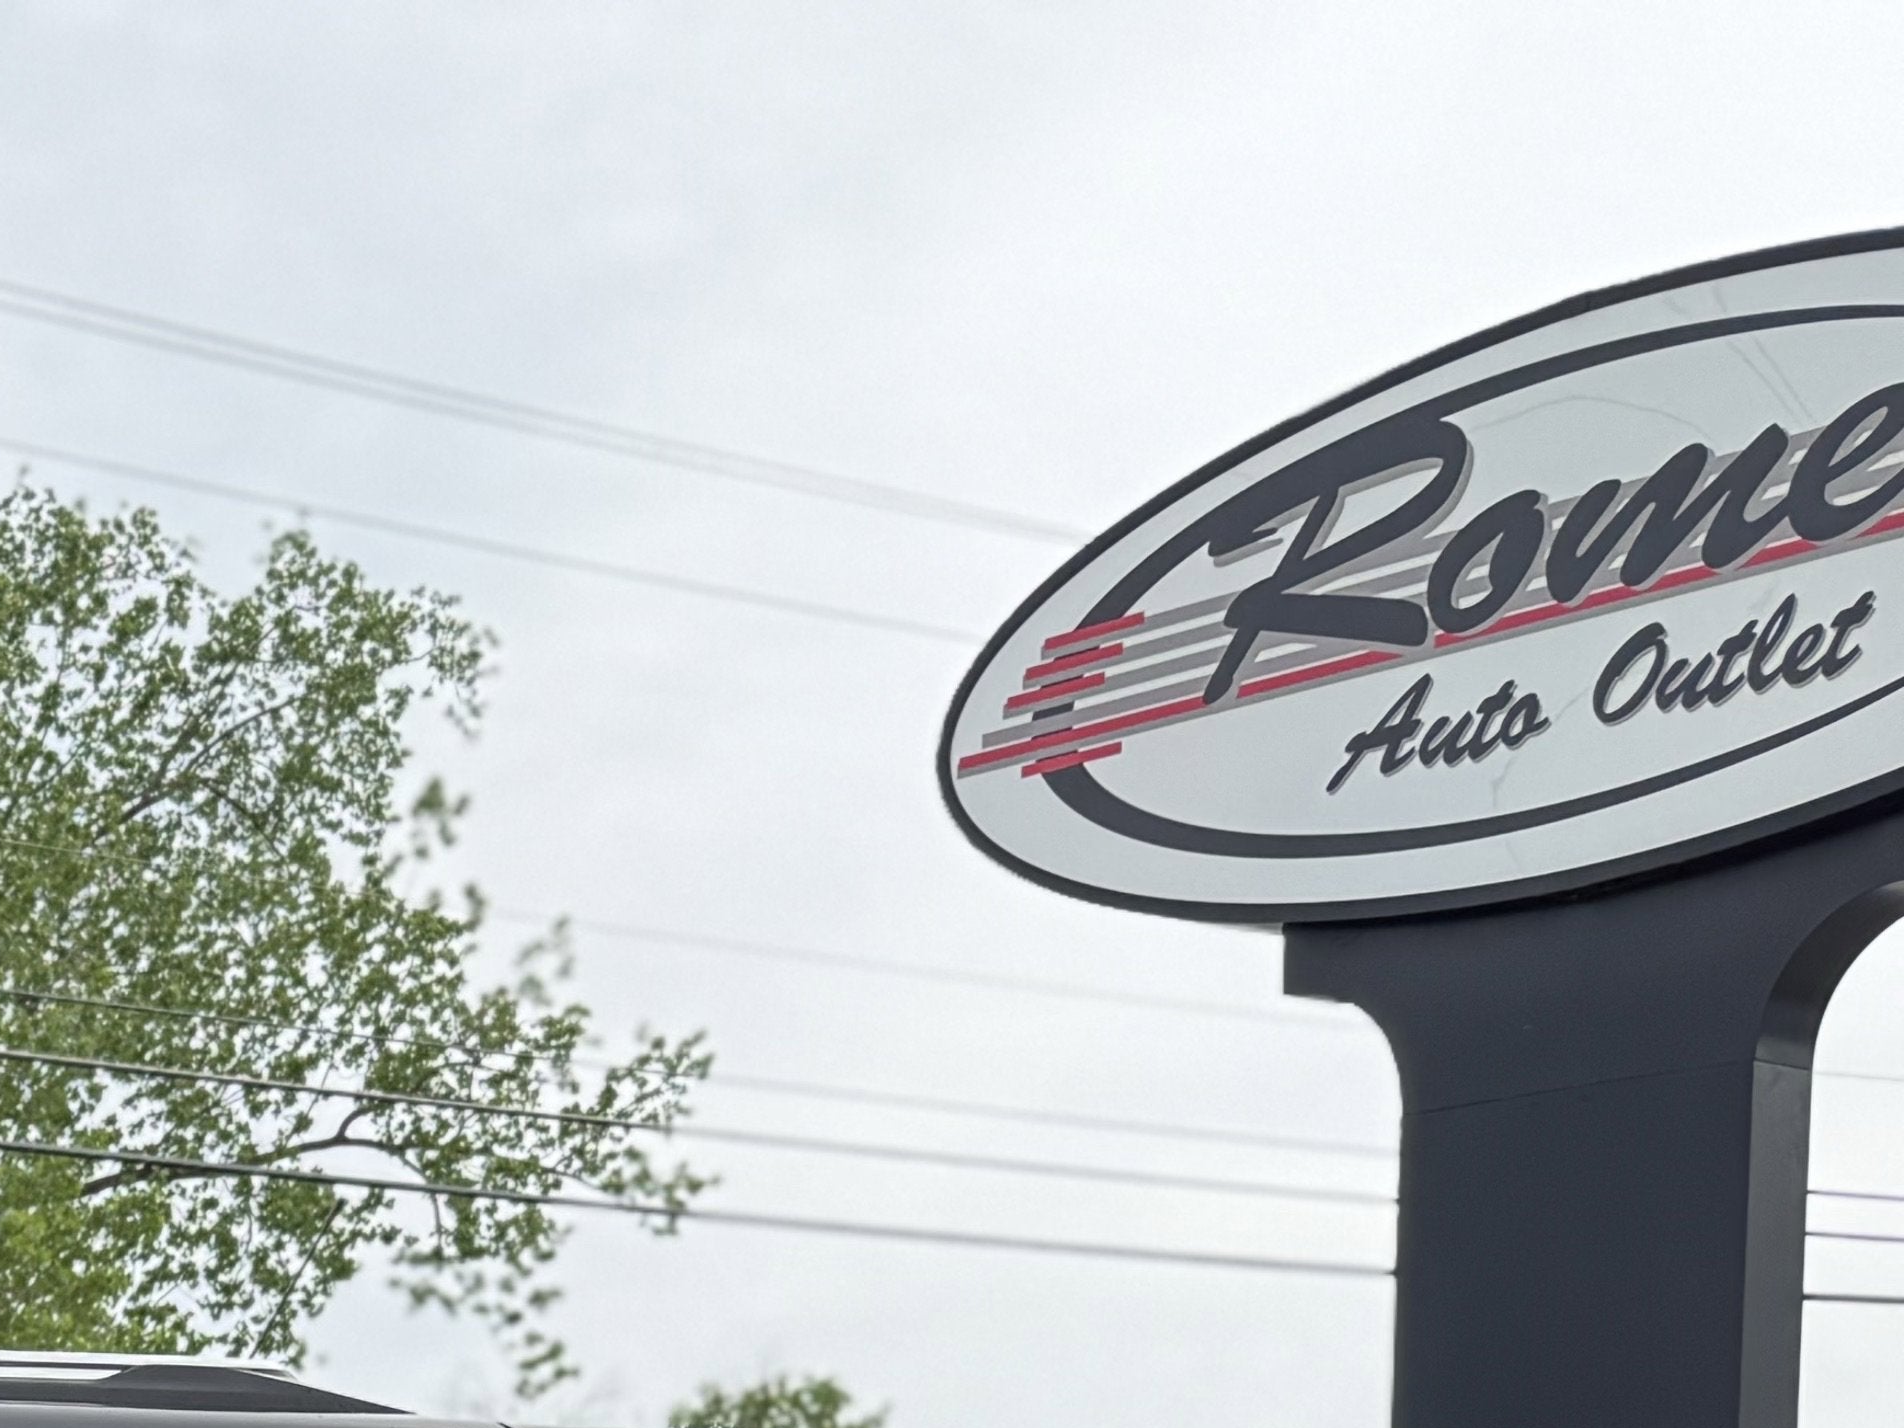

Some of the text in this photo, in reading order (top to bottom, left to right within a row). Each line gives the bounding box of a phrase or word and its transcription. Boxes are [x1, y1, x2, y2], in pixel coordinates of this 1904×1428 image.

[1202, 384, 1904, 704] Rome
[1326, 590, 1876, 795] Auto Outlet
